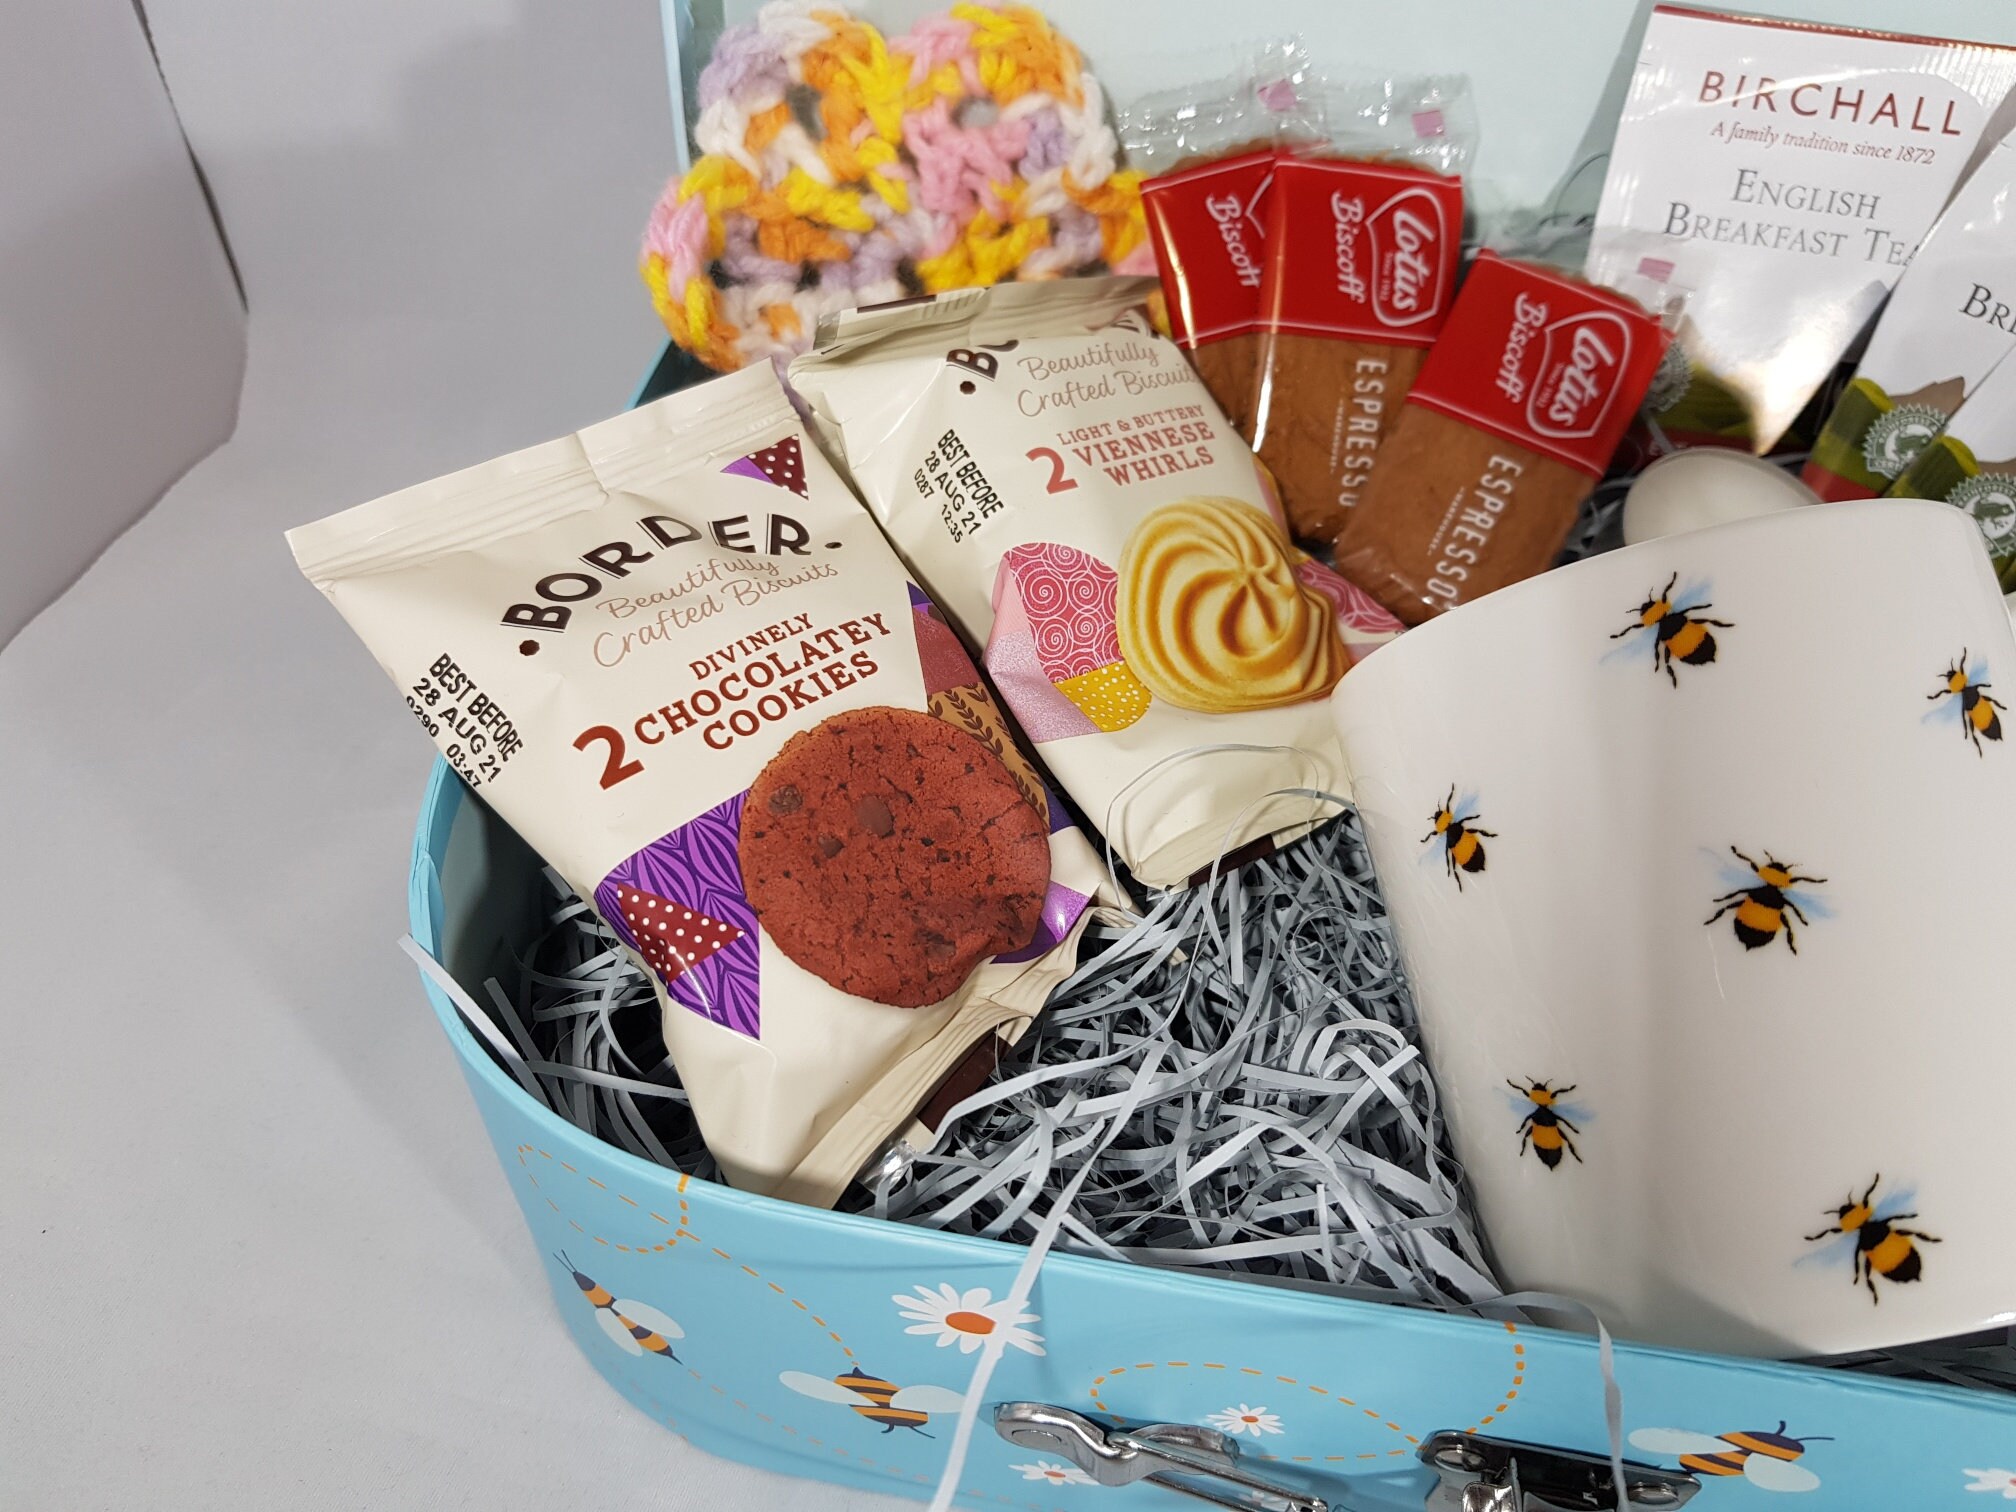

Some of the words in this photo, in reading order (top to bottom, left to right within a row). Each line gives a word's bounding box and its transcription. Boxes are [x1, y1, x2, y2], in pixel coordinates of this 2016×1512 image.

[1699, 71, 1962, 136] BIRCHALL
[1710, 120, 1724, 137] A
[1725, 121, 1779, 148] family
[1783, 130, 1848, 155] tradition
[1852, 142, 1892, 160] since
[1895, 145, 1936, 165] 1872
[1663, 202, 1848, 257] BREAKFAST
[1731, 168, 1881, 220] ENGLISH
[1331, 189, 1366, 303] Biscoff
[1017, 342, 1160, 381] Beautifully
[1496, 292, 1547, 403] Biscoff
[1018, 375, 1116, 417] Crafted
[1114, 364, 1198, 396] Biscuit
[1056, 423, 1113, 445] LIGHT
[1116, 419, 1131, 432] &
[1132, 405, 1205, 429] BUTTERY
[925, 450, 941, 473] 28
[934, 472, 965, 512] AUG
[961, 511, 982, 535] 21
[938, 429, 971, 468] BEST
[956, 461, 1004, 519] BEFORE
[1025, 447, 1079, 494] 2
[1072, 421, 1215, 467] VIENNESE
[1103, 446, 1214, 486] WHIRLS
[914, 468, 935, 499] 0287
[941, 504, 963, 543] 12:35
[1427, 455, 1523, 598] ESPRESSO
[500, 513, 812, 634] BORDER
[595, 558, 779, 619] Beautifully
[593, 595, 724, 667] Crafted
[720, 562, 839, 606] Biscuits
[689, 613, 814, 680] DIVINELY
[413, 677, 441, 706] 28
[438, 707, 486, 755] AUG
[479, 754, 501, 783] 21
[429, 652, 477, 703] BEST
[467, 692, 523, 762] BEFORE
[572, 725, 645, 790] 2
[634, 613, 891, 744] CHOCOLATEY
[703, 651, 879, 750] COOKIES
[406, 696, 439, 737] 0290
[446, 744, 482, 787] 03:47
